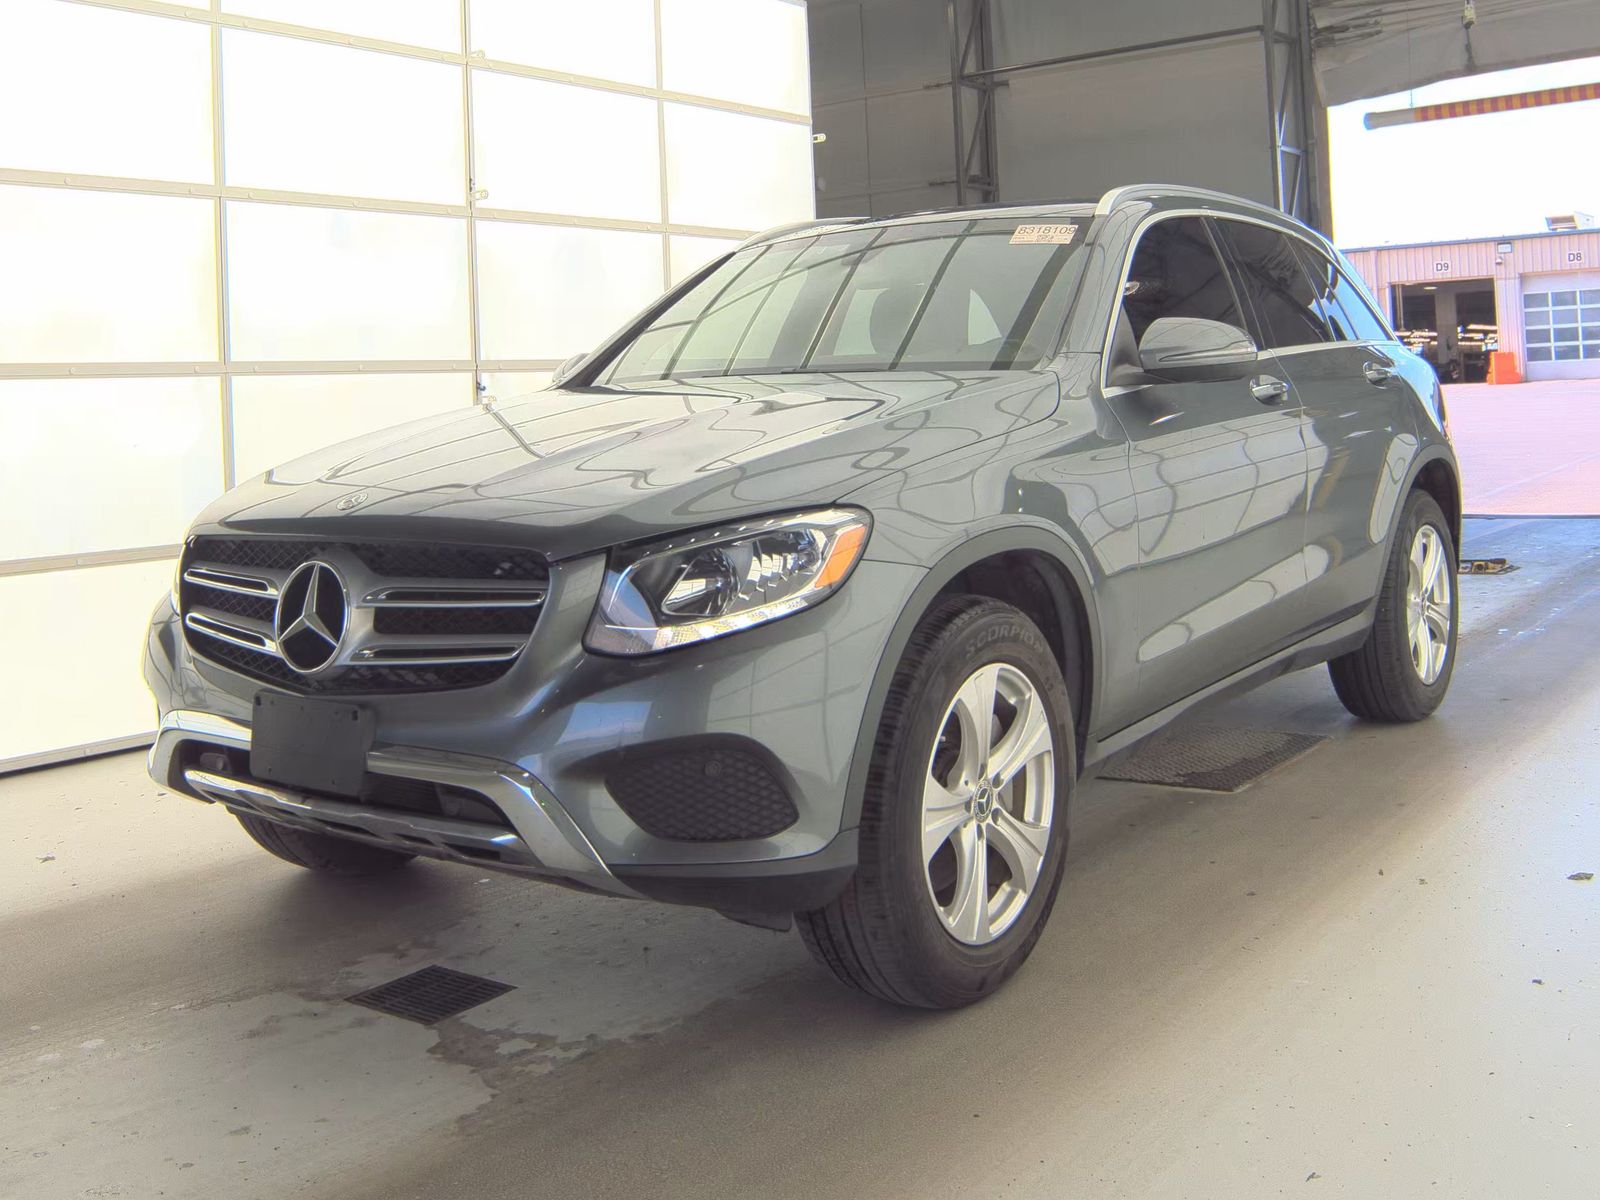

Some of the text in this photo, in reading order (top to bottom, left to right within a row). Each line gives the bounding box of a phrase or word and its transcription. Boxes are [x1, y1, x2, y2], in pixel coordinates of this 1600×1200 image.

[1018, 227, 1076, 235] 8318109
[1568, 252, 1582, 262] D8
[1436, 262, 1449, 272] D9
